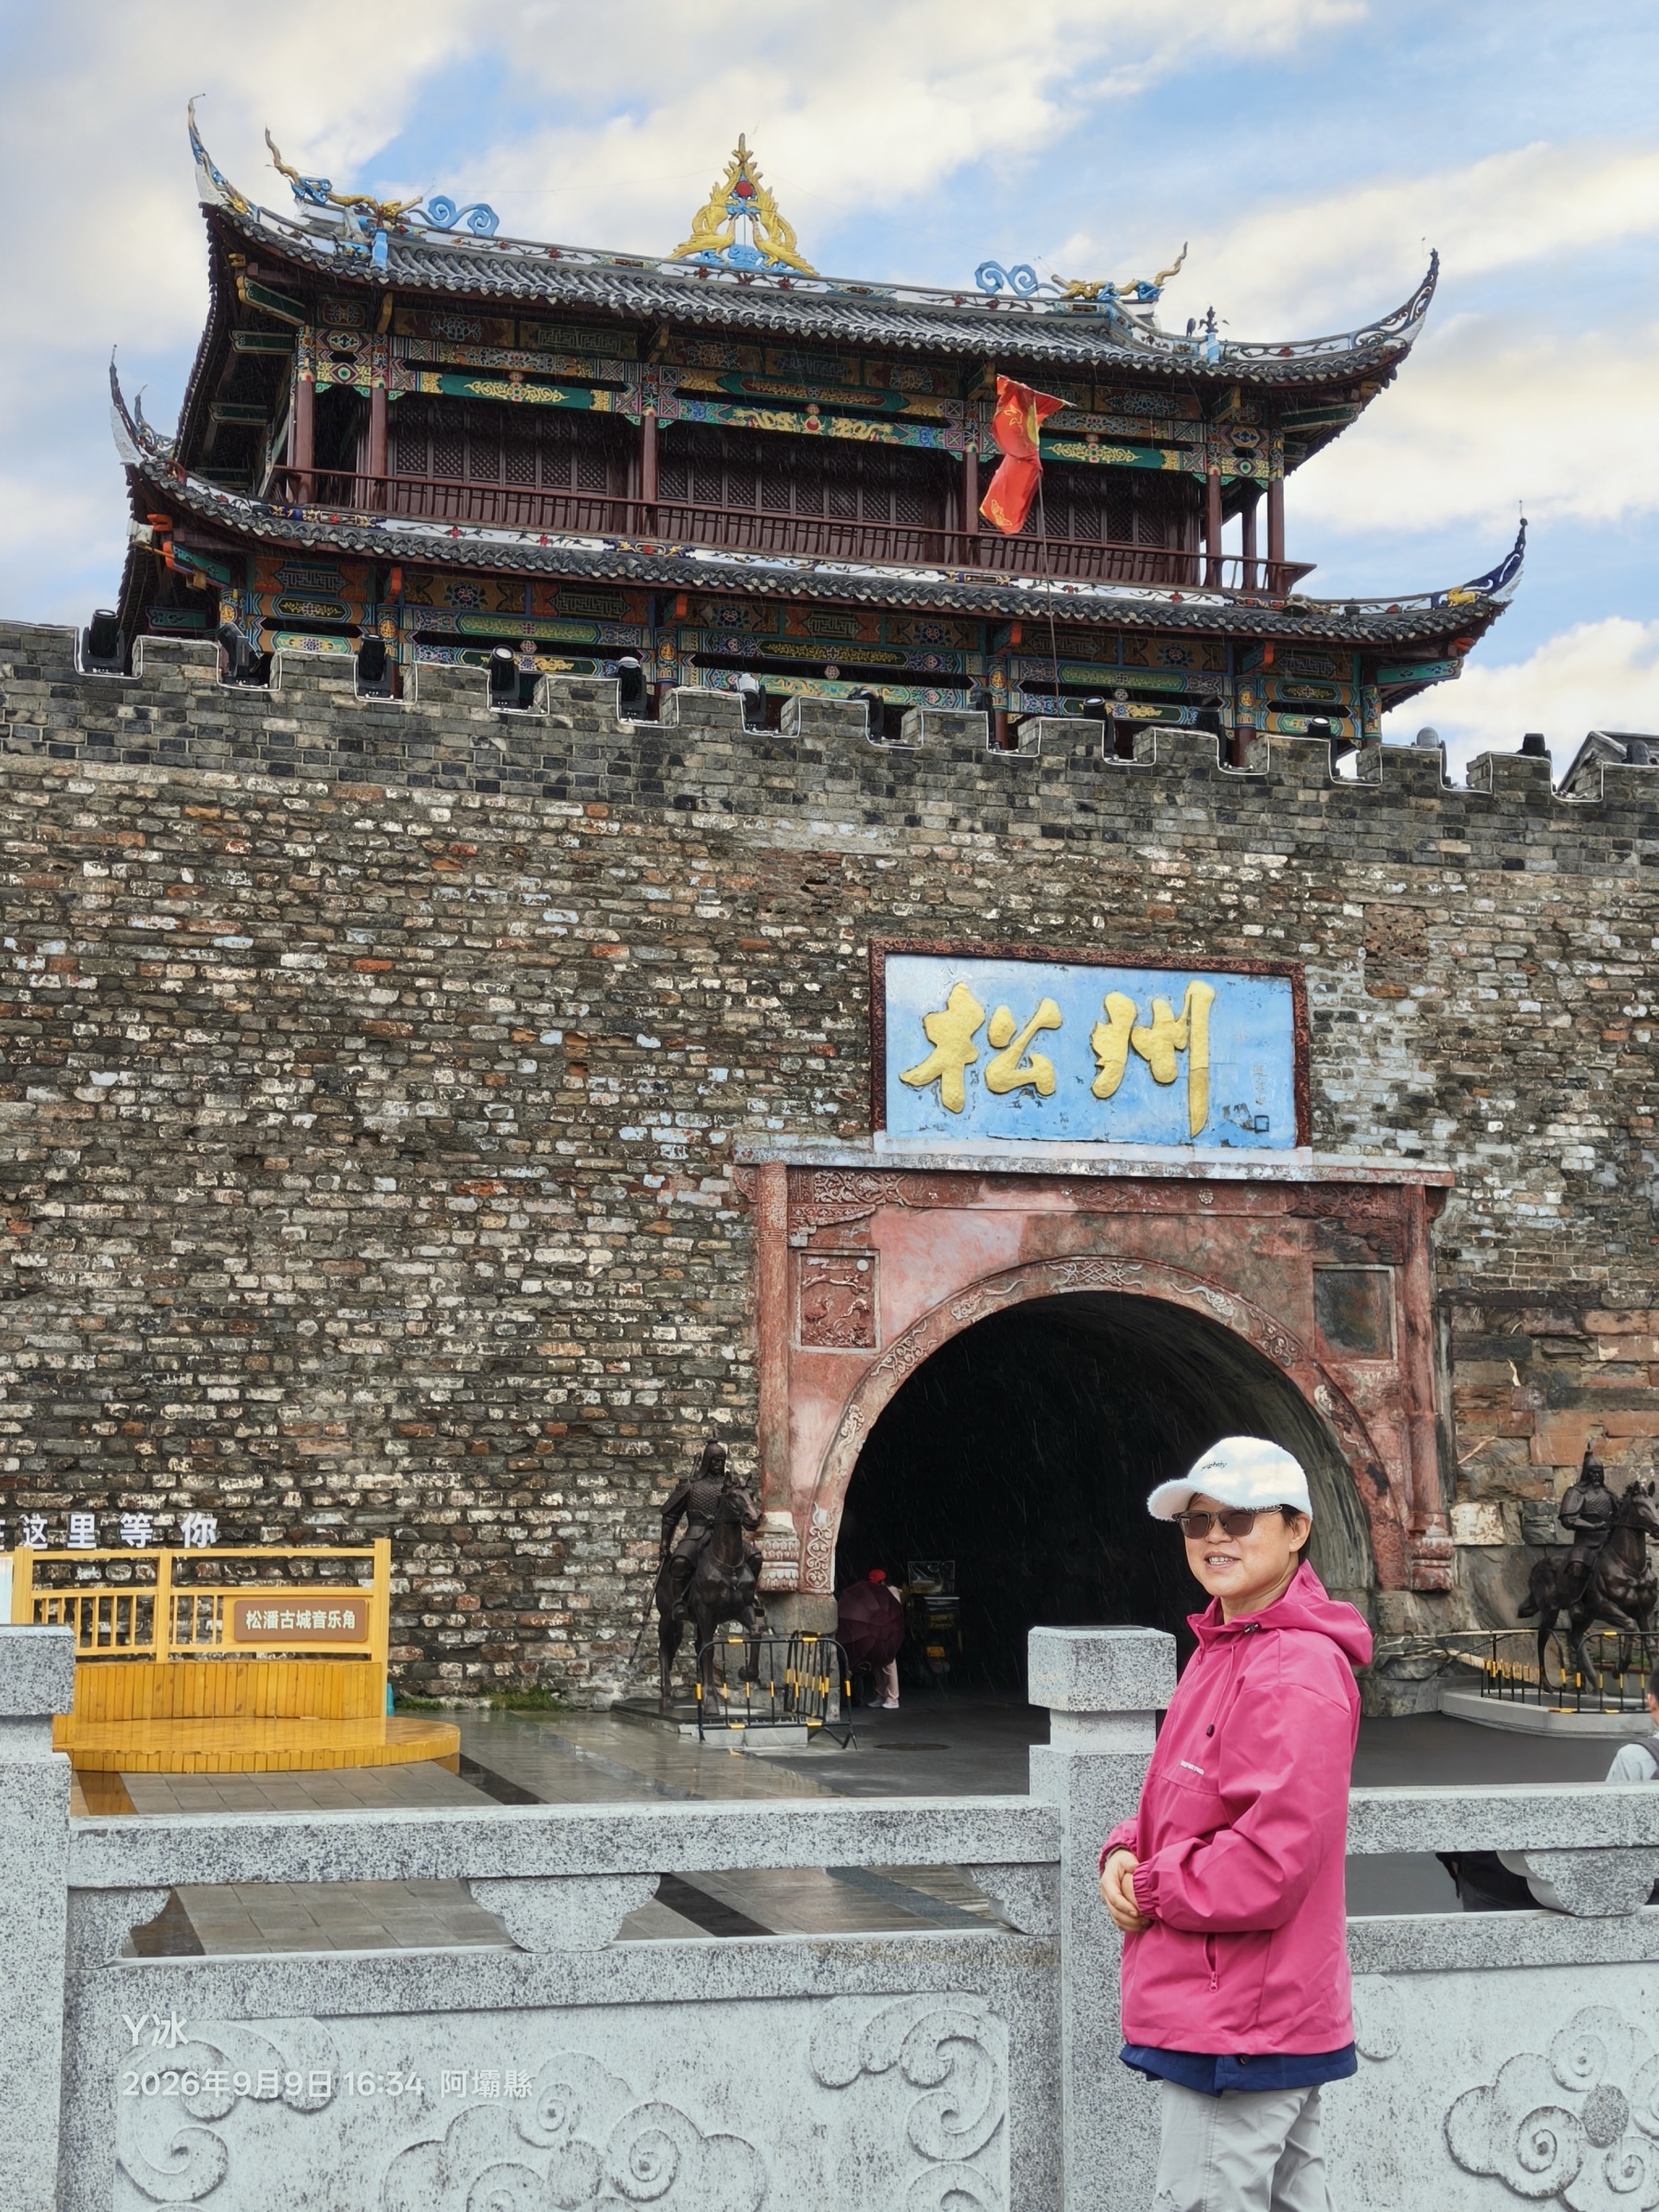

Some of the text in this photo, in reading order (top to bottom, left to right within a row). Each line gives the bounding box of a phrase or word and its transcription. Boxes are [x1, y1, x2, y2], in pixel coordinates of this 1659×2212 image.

[899, 980, 1216, 1138] 松州
[0, 1512, 218, 1550] 这里等你
[246, 1609, 355, 1630] 松潘古城音乐角
